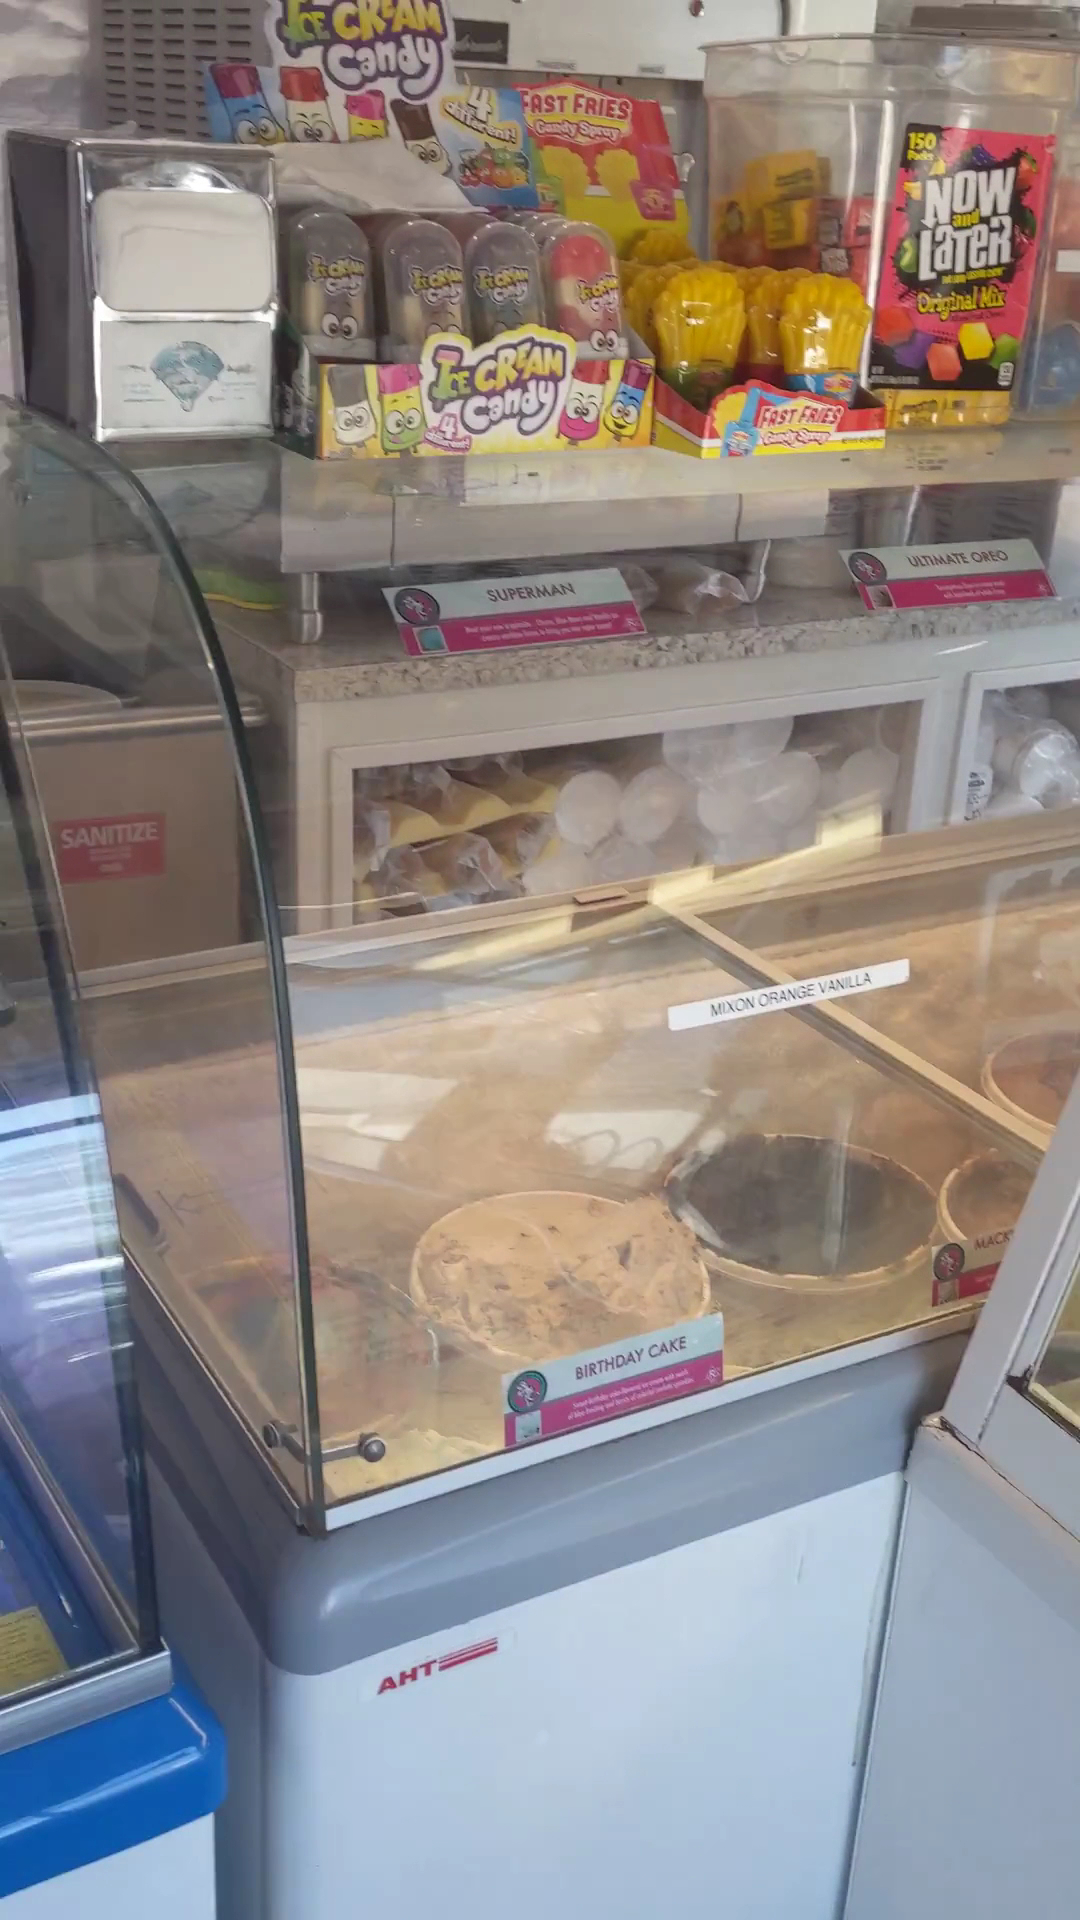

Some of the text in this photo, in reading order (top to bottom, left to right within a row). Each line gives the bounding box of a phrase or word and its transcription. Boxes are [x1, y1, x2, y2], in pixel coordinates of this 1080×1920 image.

[332, 0, 444, 40] CREAM
[327, 34, 439, 95] Candy
[469, 86, 492, 122] 4
[521, 90, 630, 120] FAST FRIES
[535, 120, 621, 142] Candy Spray
[907, 132, 937, 150] 150
[921, 166, 1017, 228] NOW
[952, 208, 980, 227] and
[916, 285, 1008, 321] Original Mix
[432, 342, 564, 400] ICE CREAM
[463, 379, 556, 431] Candy
[759, 405, 842, 427] FAST FRIES
[439, 414, 456, 439] 4
[906, 549, 1009, 568] ULTIMATE OREO
[486, 582, 576, 603] SUPERMAN
[60, 821, 160, 849] SANITIZE
[710, 971, 873, 1018] MIXON ORANGE VANILLA
[574, 1335, 688, 1381] BIRTHDAY CAKE
[376, 1658, 438, 1695] AHT
